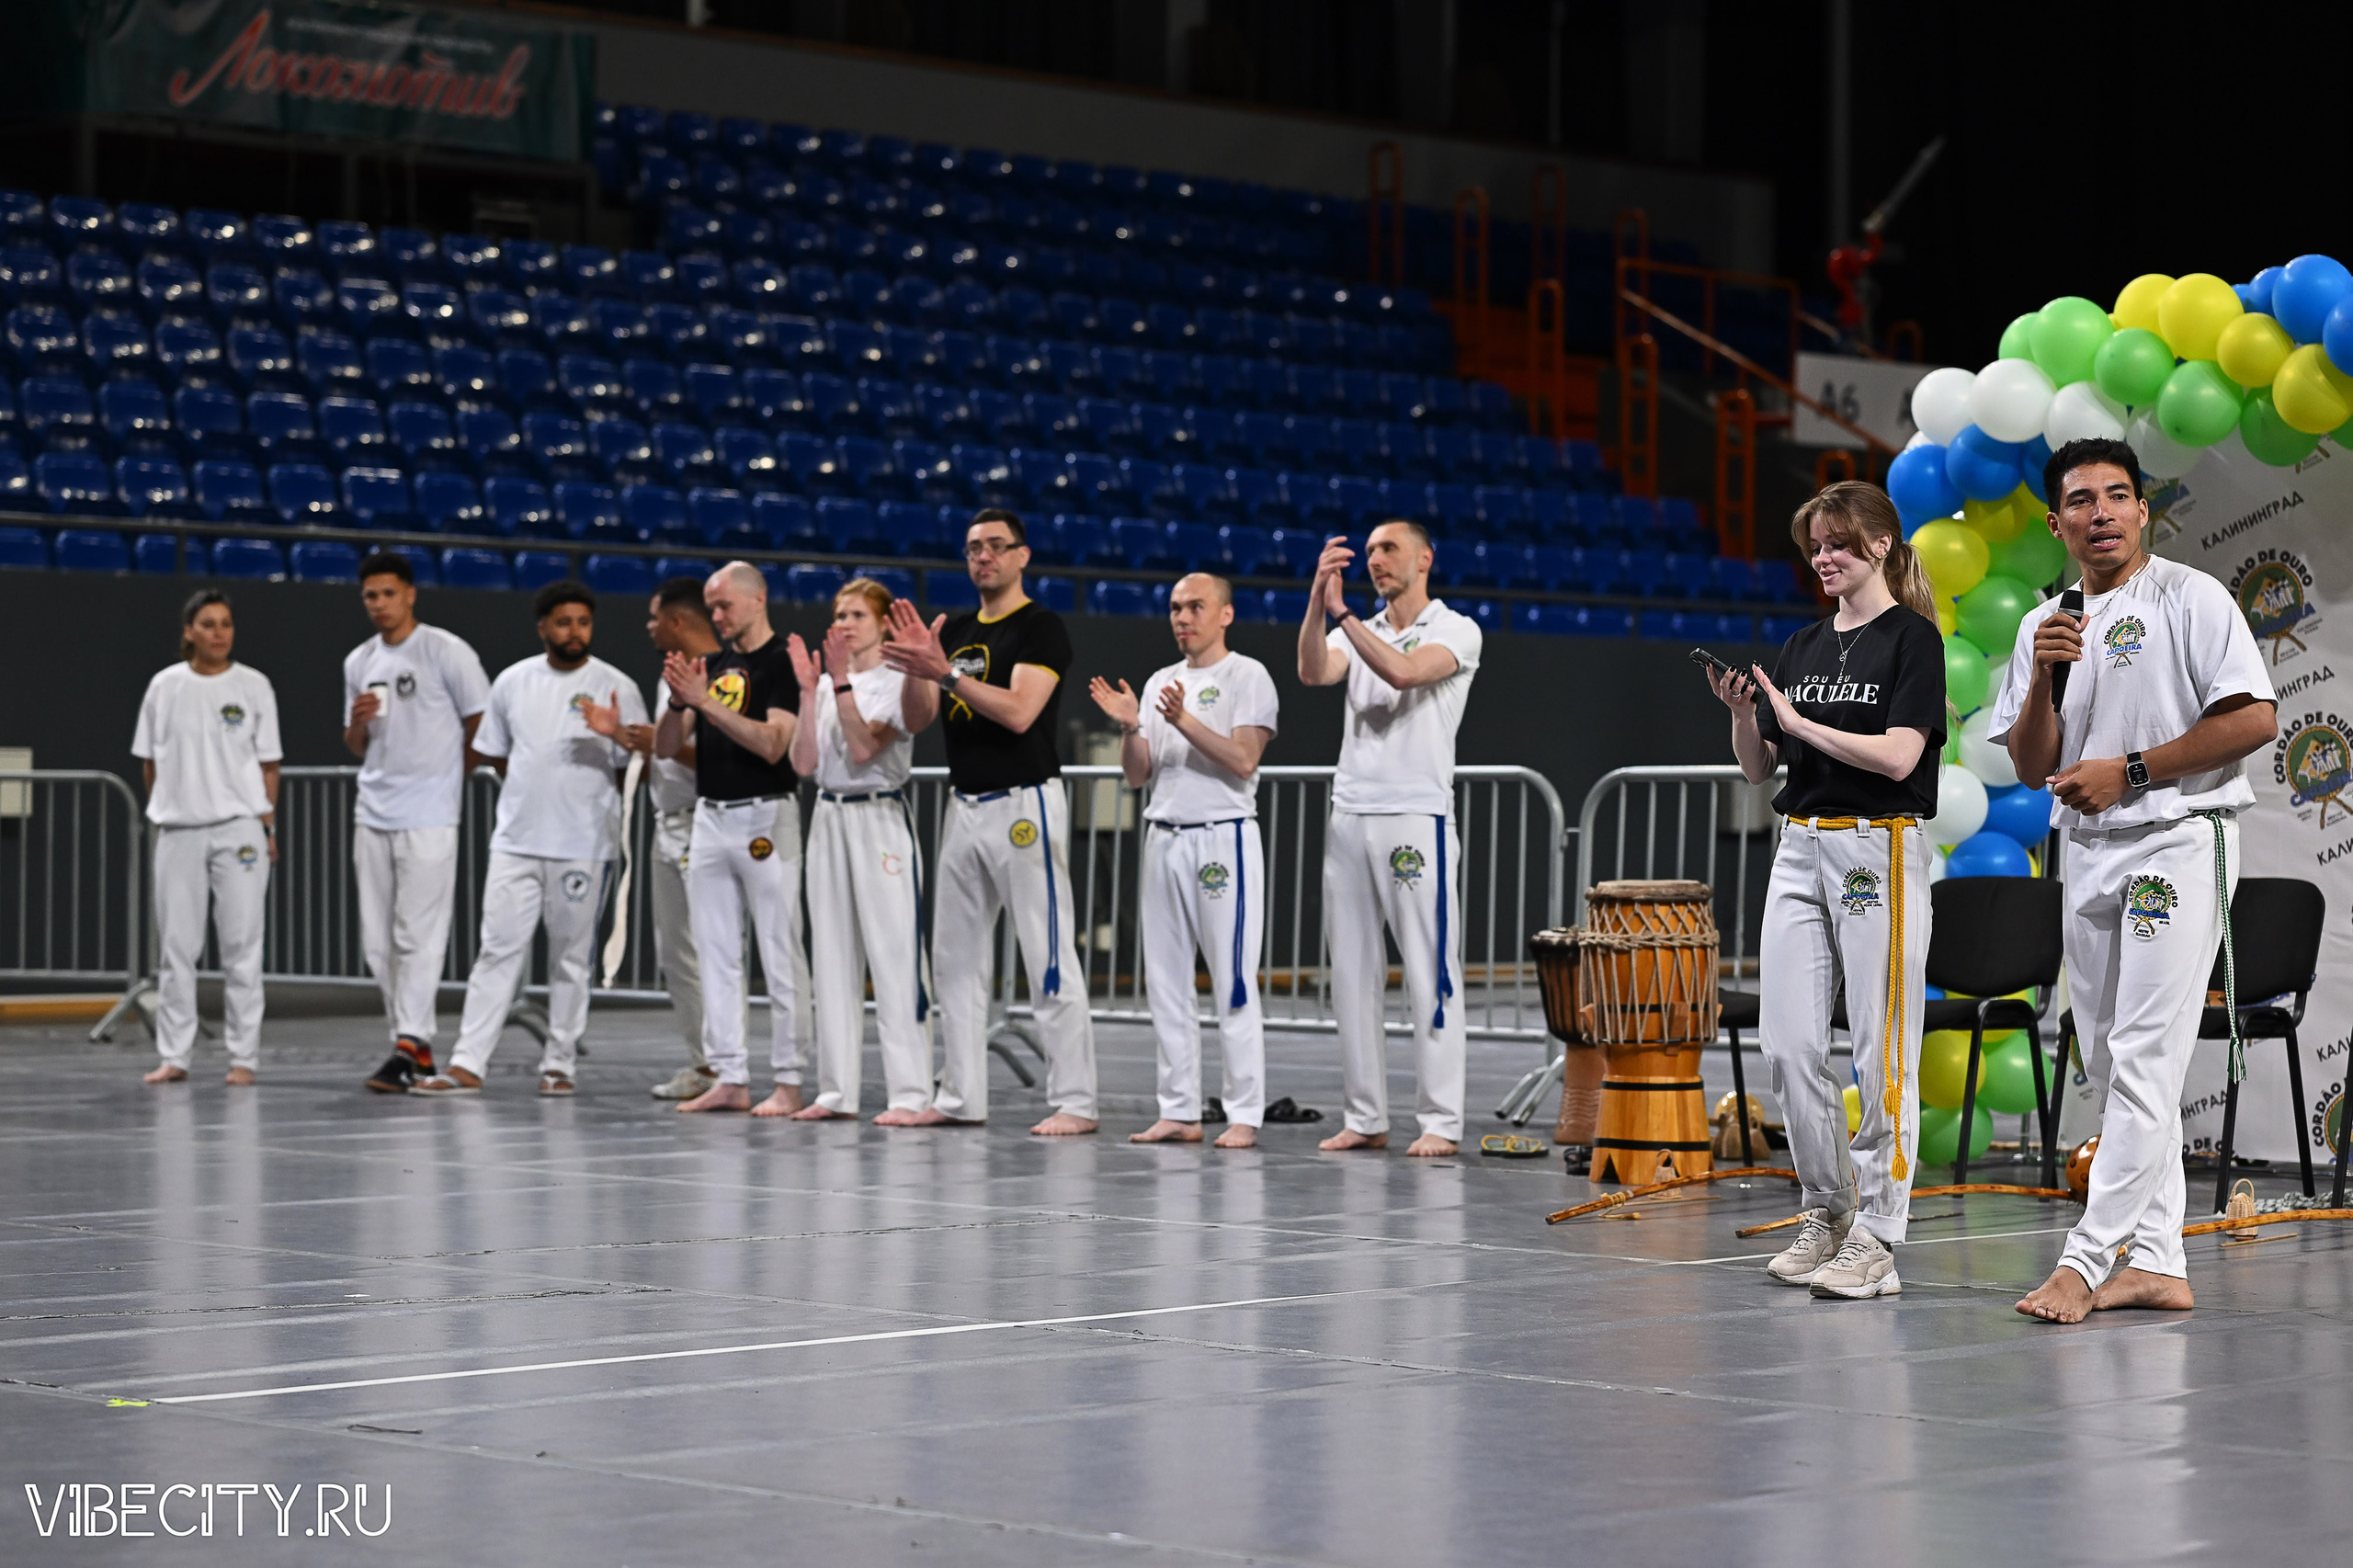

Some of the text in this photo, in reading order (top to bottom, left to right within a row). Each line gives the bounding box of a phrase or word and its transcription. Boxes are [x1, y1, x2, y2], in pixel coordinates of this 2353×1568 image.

[2200, 491, 2304, 551] КАЛИНИНГРАД
[2257, 549, 2277, 563] DE
[2279, 551, 2313, 587] OURO
[2103, 618, 2124, 645] CORDÃO
[2134, 618, 2146, 637] OURO
[2106, 643, 2143, 656] CAPOEIRA
[1802, 675, 1851, 684] SOU EU
[2277, 665, 2336, 702] ИНГРАД
[2273, 720, 2302, 785] CORDÃO
[2304, 710, 2323, 725] DE
[2153, 875, 2165, 883] DE
[2165, 883, 2178, 908] OURO
[2312, 1083, 2342, 1147] CORDÃO
